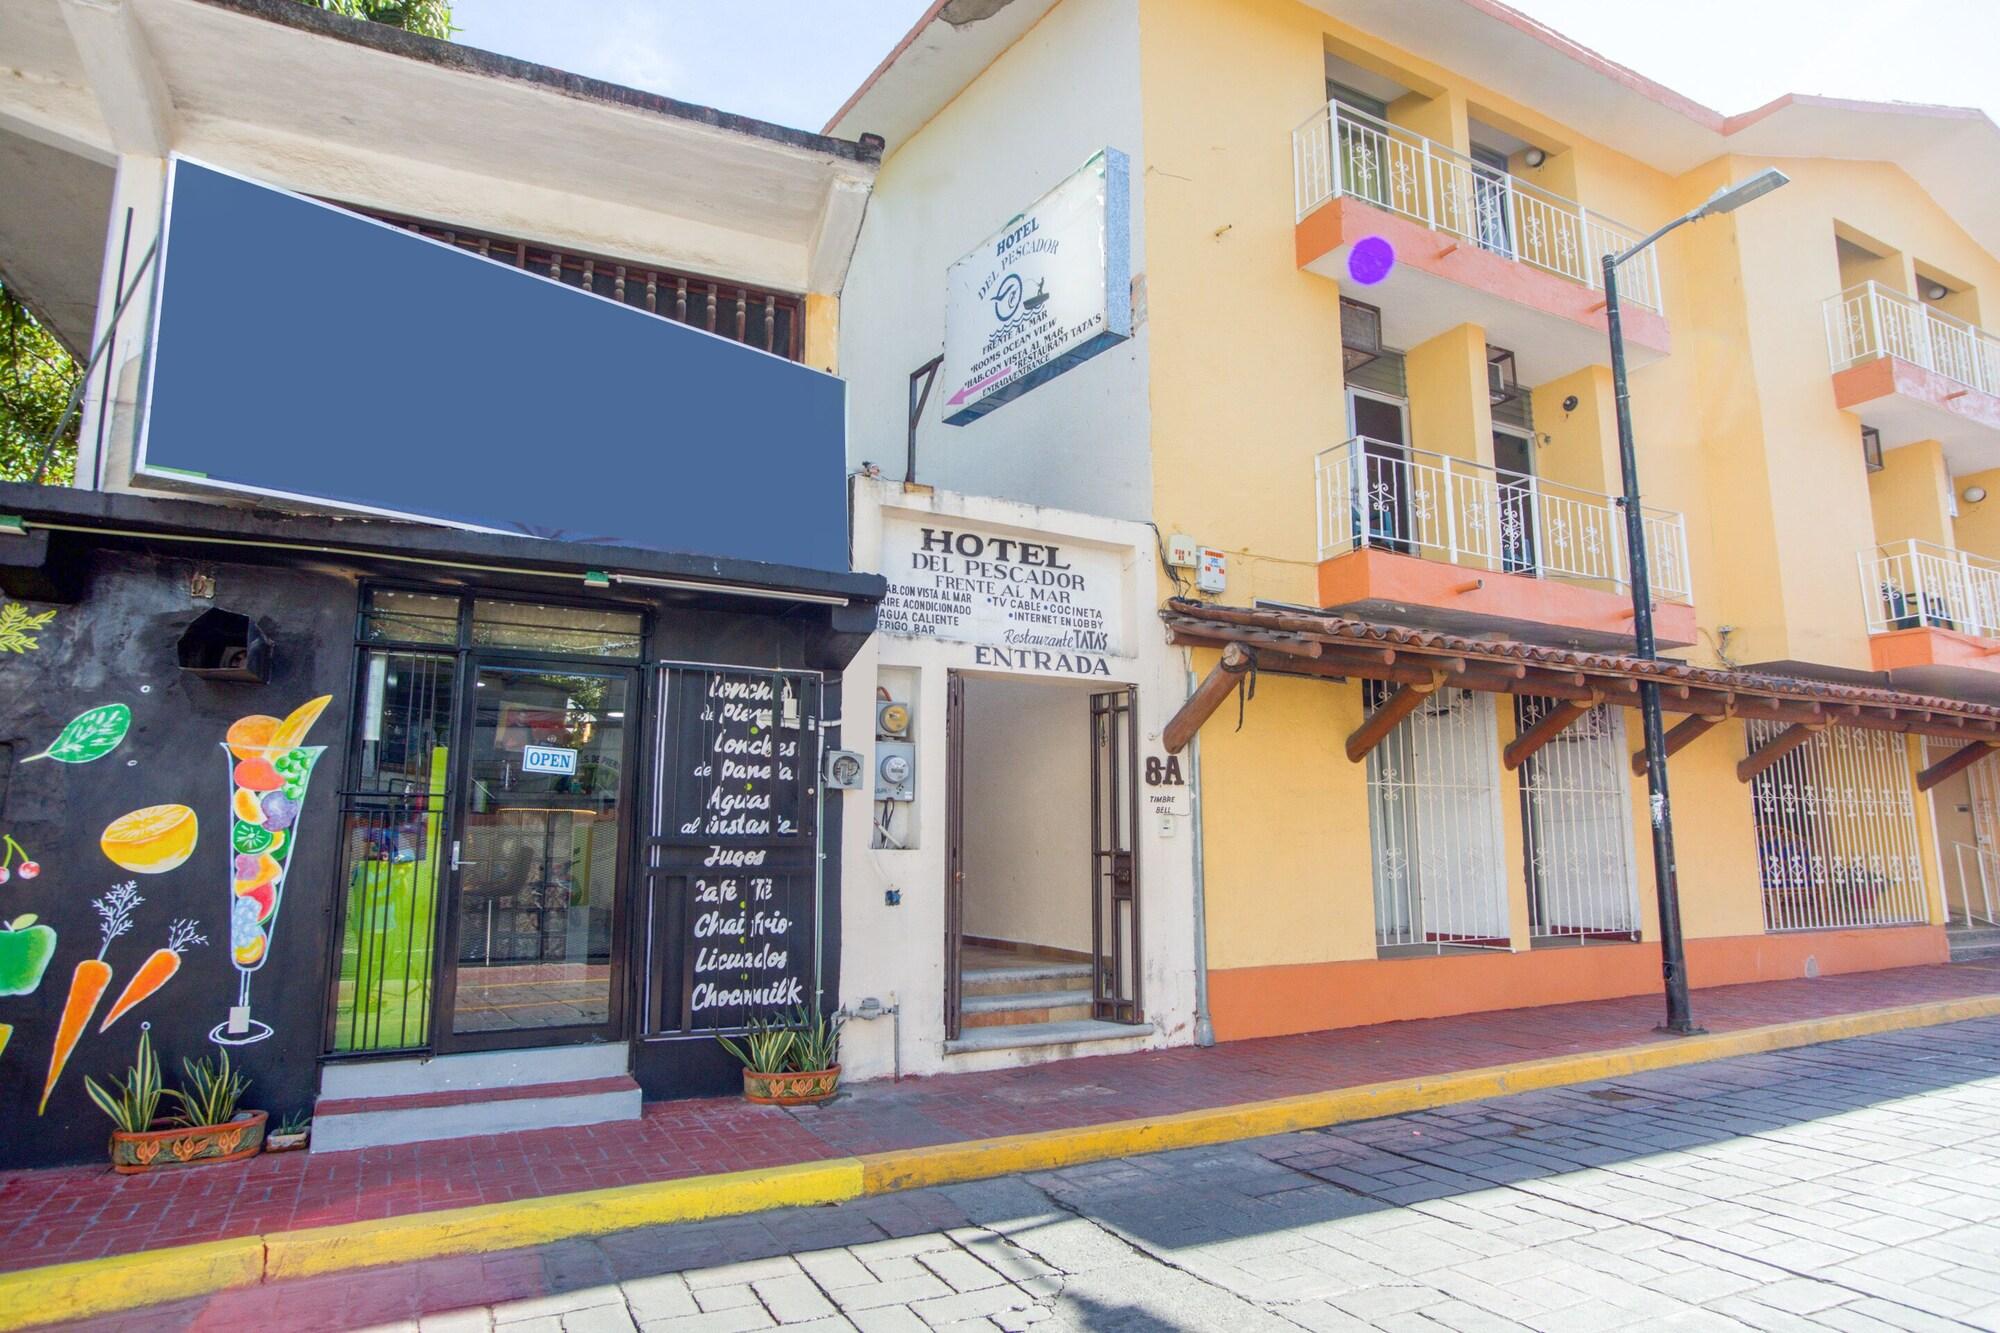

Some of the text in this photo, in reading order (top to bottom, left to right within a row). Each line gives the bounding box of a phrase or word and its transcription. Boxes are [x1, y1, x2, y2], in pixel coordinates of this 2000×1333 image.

[997, 217, 1039, 256] HOTEL
[978, 238, 1059, 300] DEL PESCADOR
[973, 318, 1057, 373] ROOMS OCEAN VIEW
[982, 310, 1048, 355] FRENTE AL MAR
[1017, 313, 1101, 369] RESTAURANT TATA'S
[1004, 349, 1027, 368] VISTA
[1030, 341, 1041, 353] AL
[1044, 326, 1064, 343] MAR
[920, 528, 1071, 570] HOTEL
[912, 552, 1085, 591] DEL PESCADOR
[886, 584, 899, 595] AB.
[917, 587, 938, 600] VISTA
[941, 590, 951, 601] AL
[953, 591, 972, 603] MAR
[936, 575, 1071, 604] FRENTE AL MAR
[879, 609, 959, 626] AGUA CALIENTE
[880, 597, 972, 615] AIRE ACONDICIONADO
[992, 596, 1103, 619] TV CABLE COCINETA
[879, 620, 936, 635] FRIGO BAR
[1014, 612, 1104, 629] INTERNET EN LOBBY
[1003, 628, 1108, 651] Restaurante TATA'S
[975, 645, 1112, 676] ENTRADA
[709, 675, 786, 700] Lonch
[530, 752, 571, 768] OPEN
[1145, 755, 1185, 786] 8-A
[706, 785, 770, 816] Aguas
[1150, 795, 1176, 803] TIMBRE
[1156, 806, 1171, 814] BELL
[681, 816, 701, 834] al
[704, 845, 767, 868] Jugos
[696, 880, 737, 904] Café
[694, 910, 745, 938] Chai
[695, 943, 787, 973] Licuados
[692, 977, 803, 1011] Chocomilk
